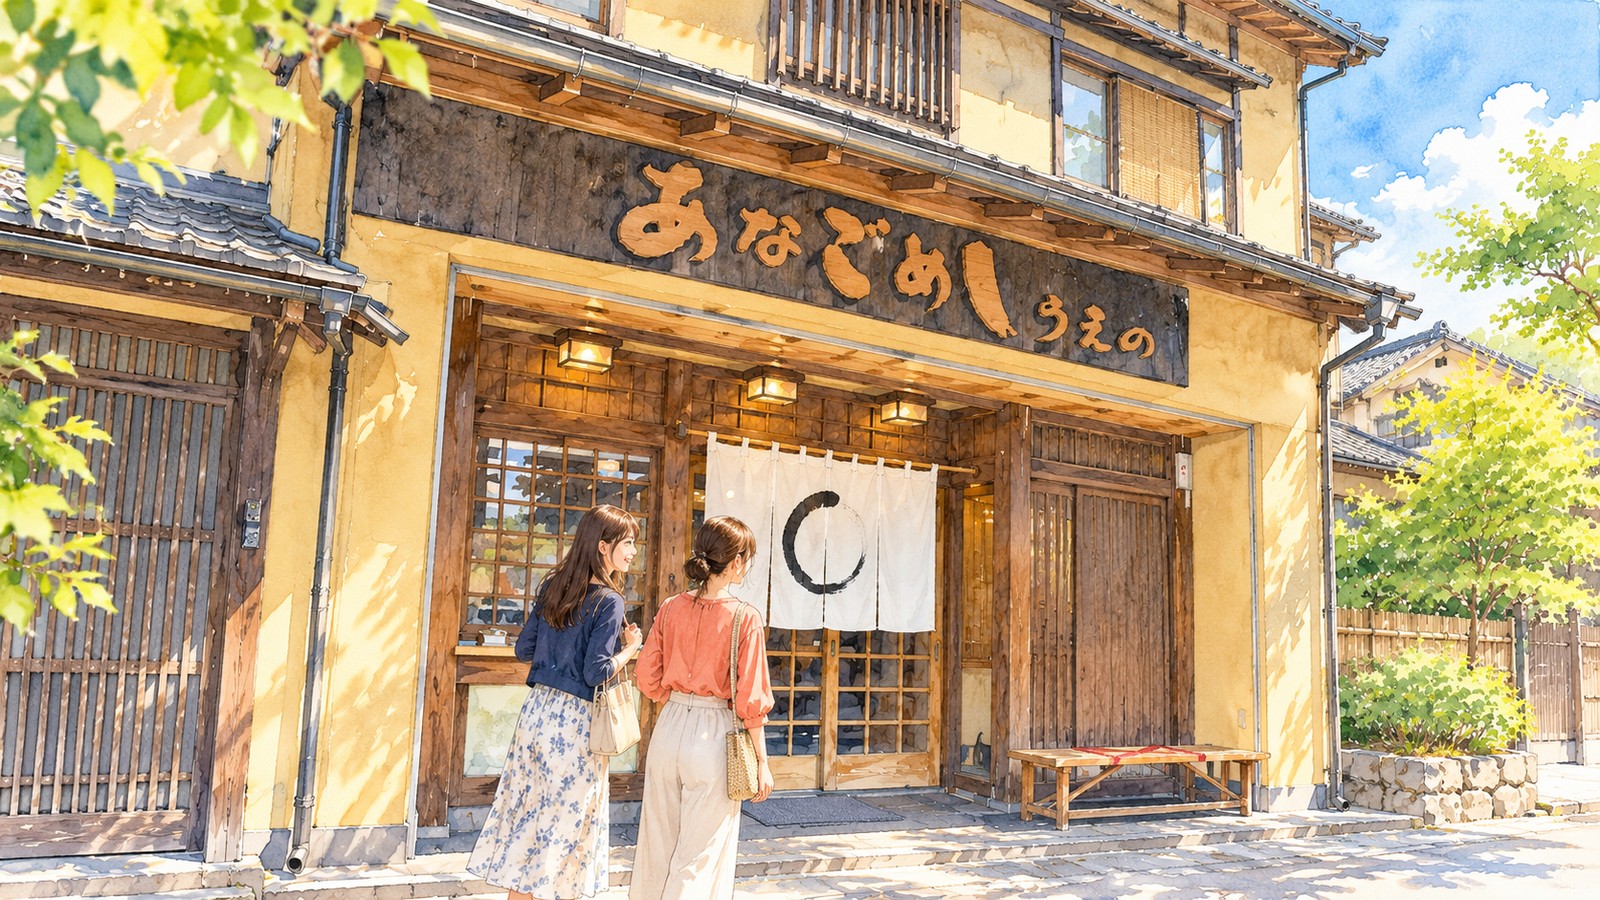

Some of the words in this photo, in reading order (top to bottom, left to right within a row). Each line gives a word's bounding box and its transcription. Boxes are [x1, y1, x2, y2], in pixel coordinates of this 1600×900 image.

[617, 160, 1017, 339] あなごめし
[1034, 293, 1156, 360] うえの
